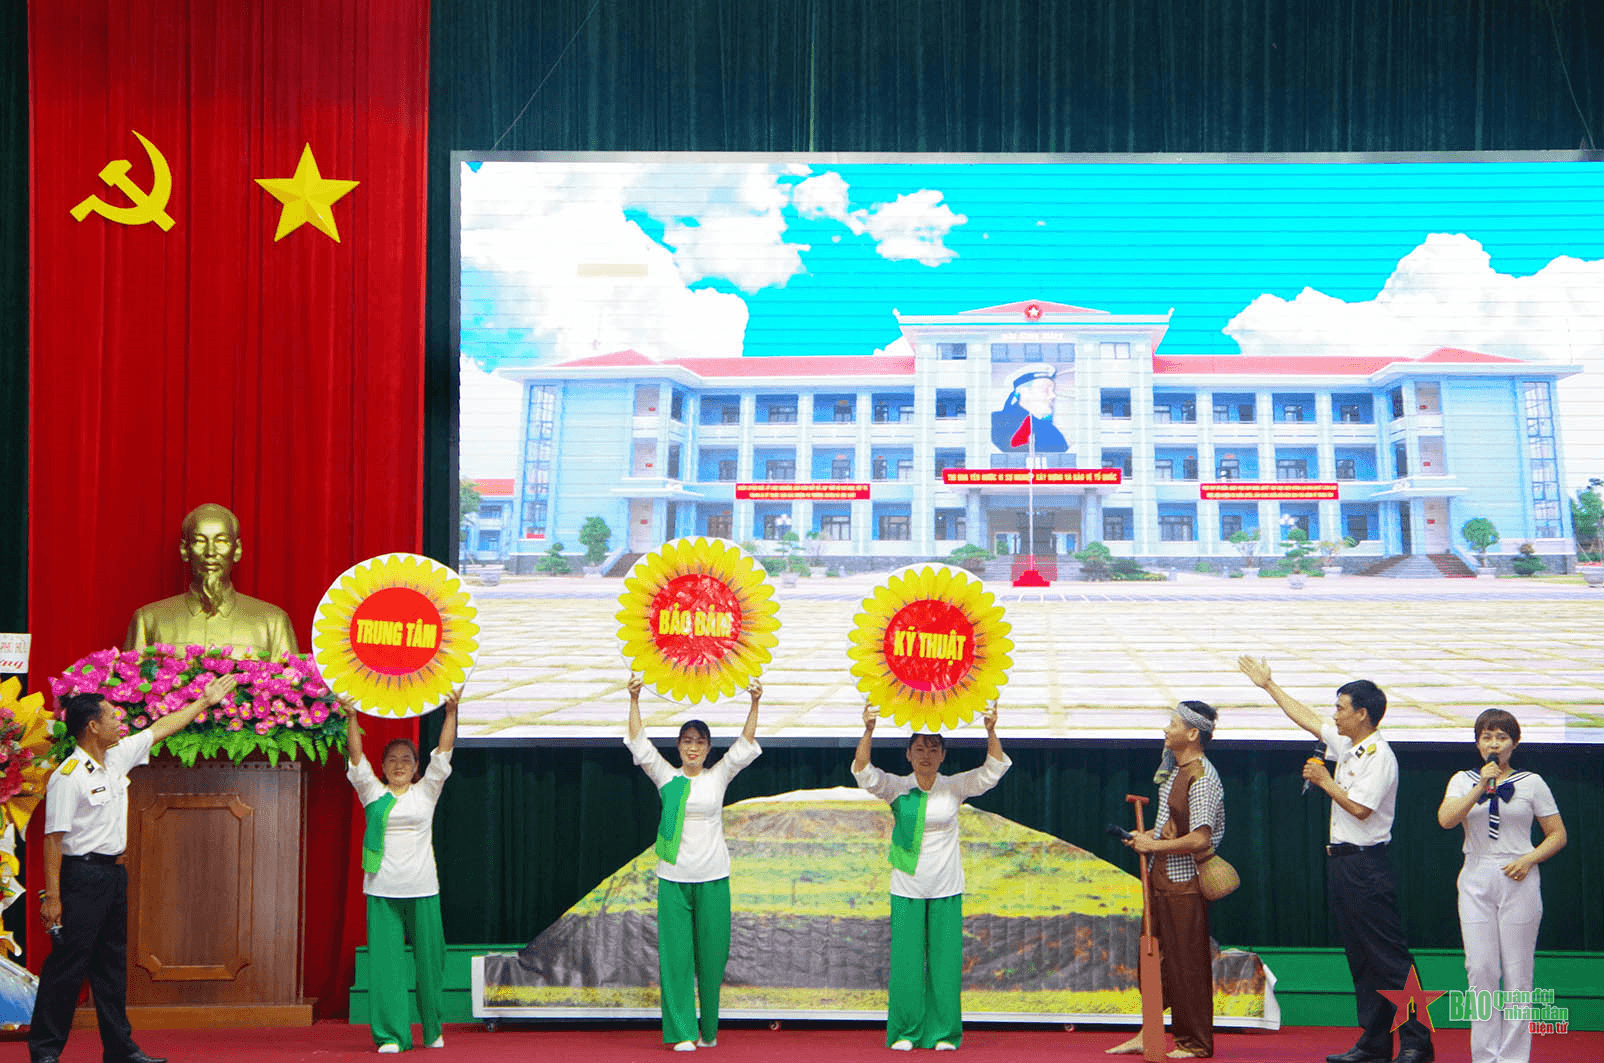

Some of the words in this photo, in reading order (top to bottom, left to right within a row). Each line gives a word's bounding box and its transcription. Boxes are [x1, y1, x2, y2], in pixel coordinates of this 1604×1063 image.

[356, 619, 403, 646] TRUNG
[406, 618, 437, 648] TÂM
[659, 602, 691, 636] BẢO
[919, 629, 966, 666] THUẬT
